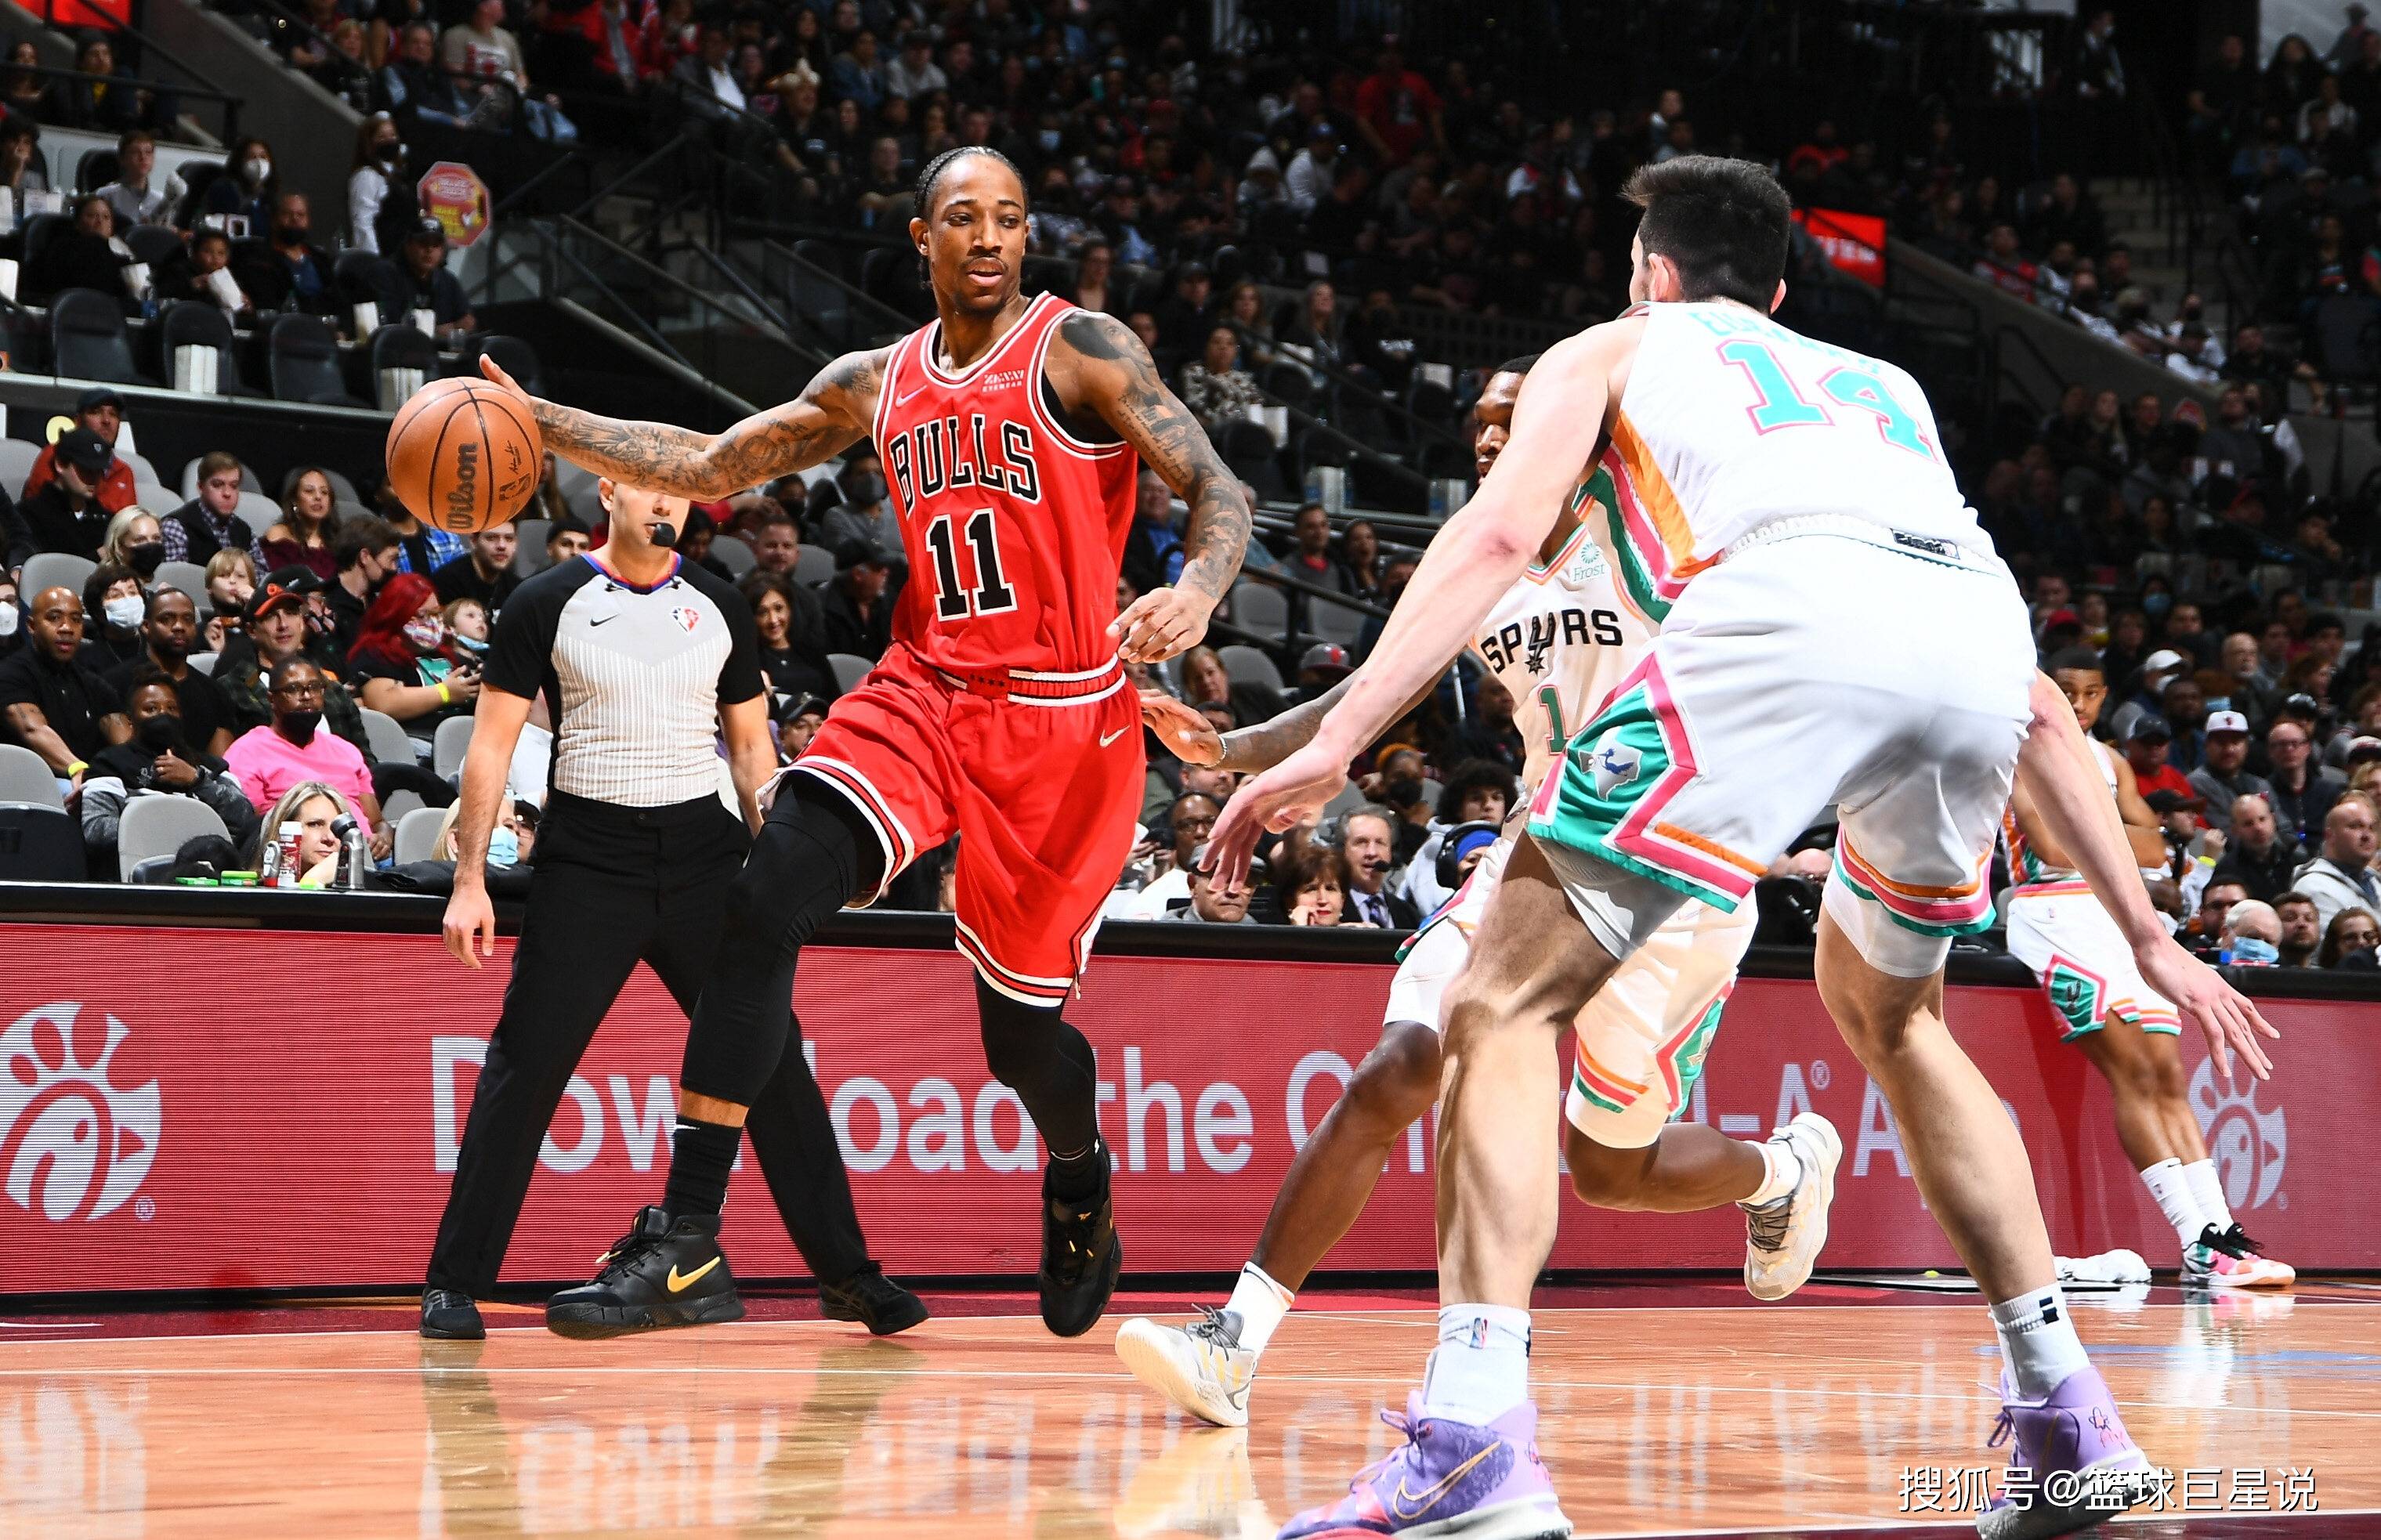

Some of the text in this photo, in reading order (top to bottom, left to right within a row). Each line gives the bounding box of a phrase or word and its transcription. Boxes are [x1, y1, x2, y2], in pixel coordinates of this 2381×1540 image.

[1716, 338, 1941, 465] 14
[446, 441, 478, 529] Wilson
[888, 413, 1043, 520] BULLS
[925, 507, 1018, 622] 11
[1572, 563, 1605, 582] Frost
[1480, 608, 1623, 676] SPURS
[1536, 684, 1575, 757] 1
